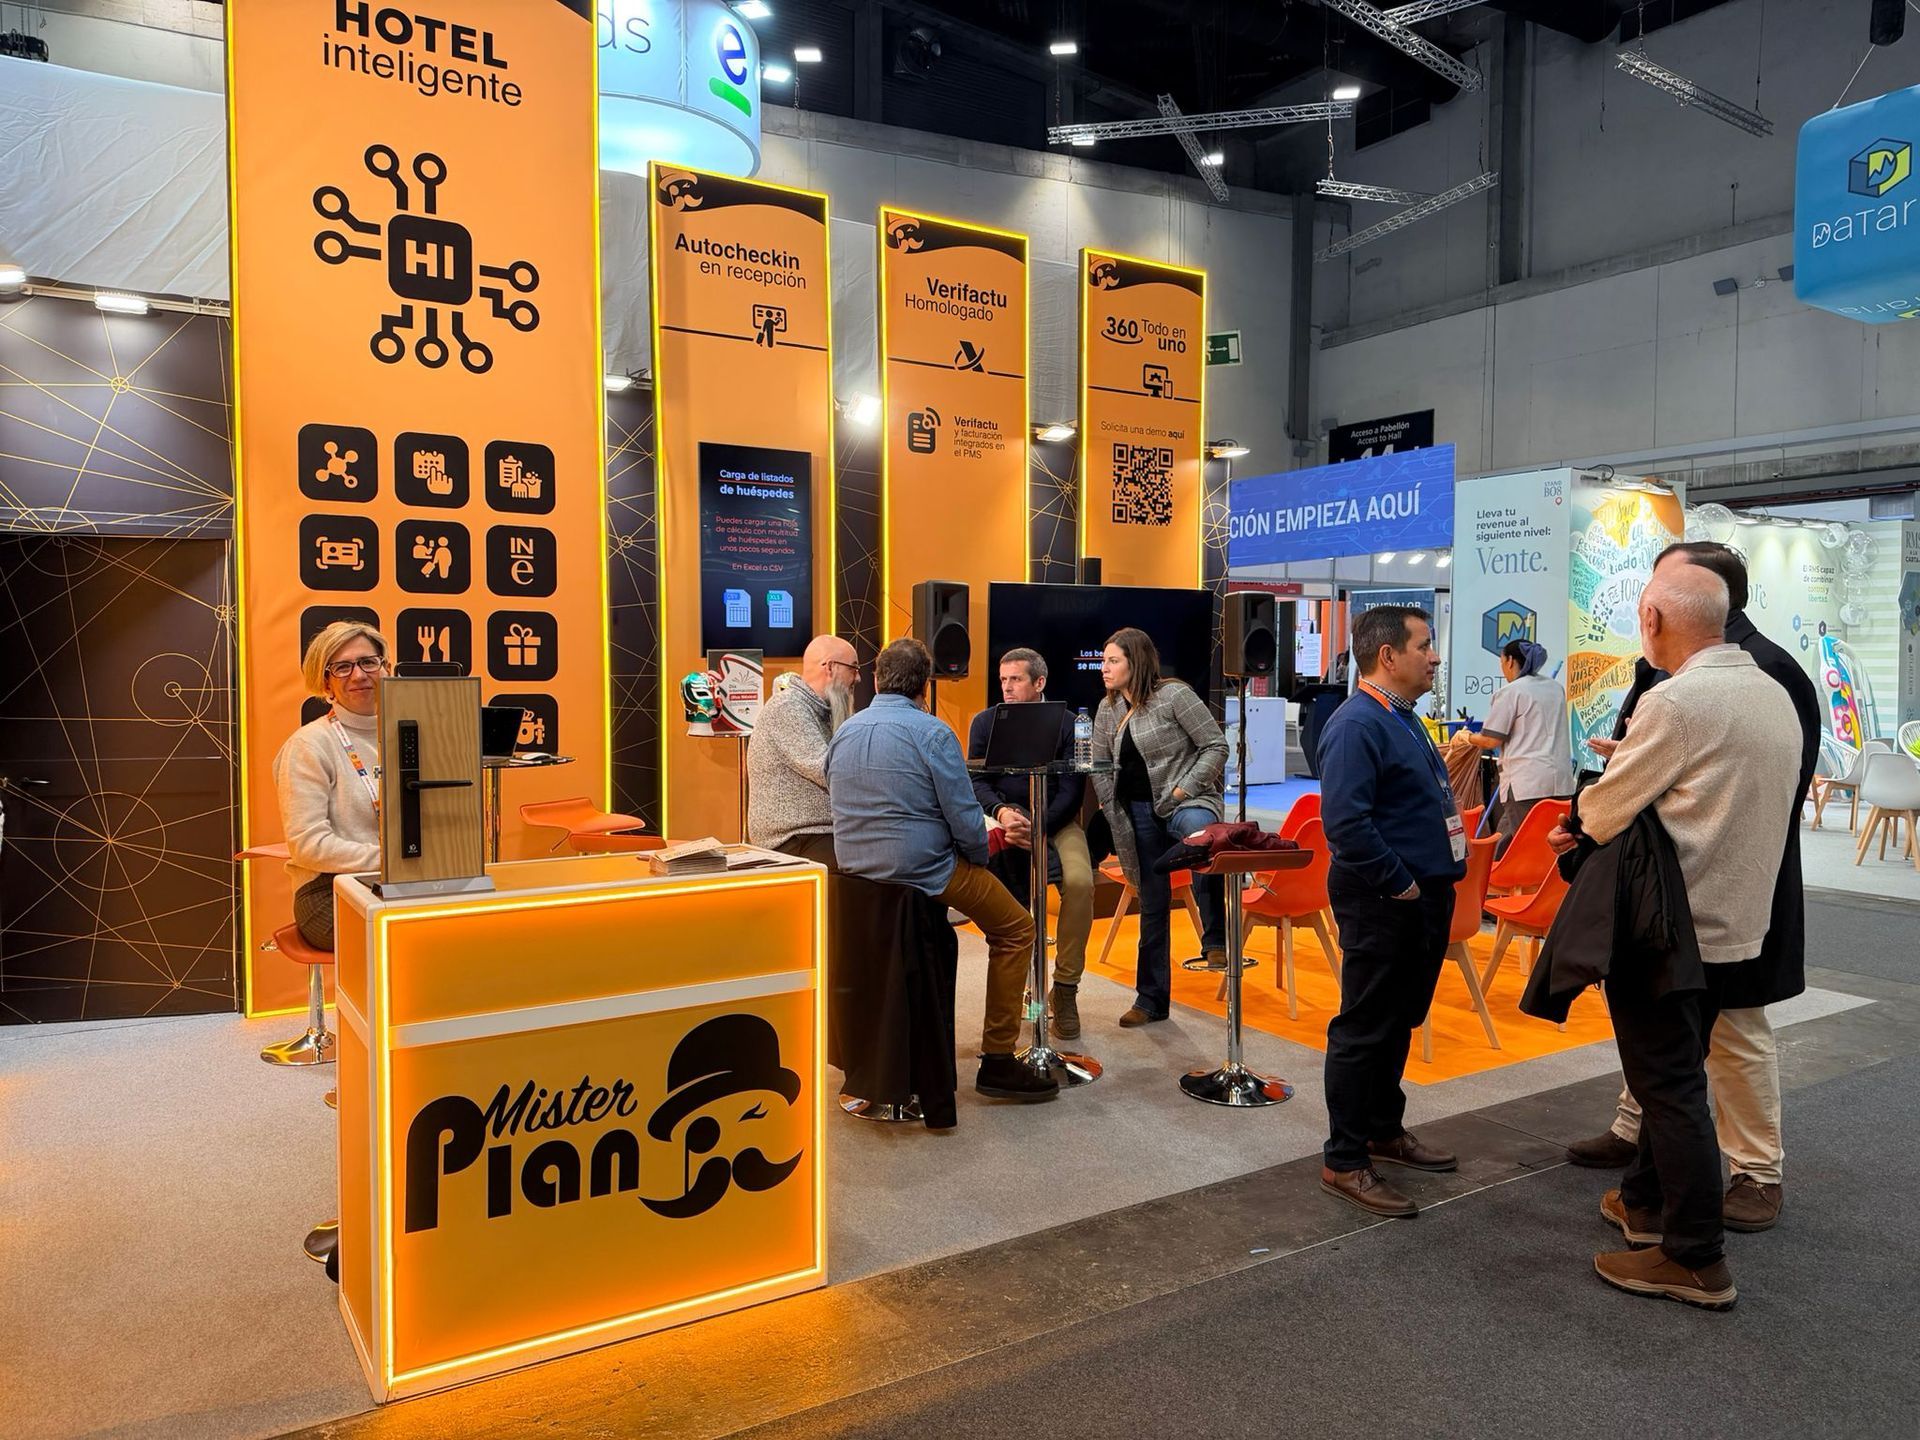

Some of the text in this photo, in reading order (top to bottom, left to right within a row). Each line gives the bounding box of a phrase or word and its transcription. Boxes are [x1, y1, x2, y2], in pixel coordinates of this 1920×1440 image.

[336, 0, 508, 69] HOTEL
[323, 33, 522, 107] inteligente
[675, 233, 800, 270] Autocheckin
[405, 238, 454, 283] HI
[700, 261, 807, 289] en recepción
[926, 277, 1007, 308] Verifactu
[905, 293, 994, 321] Homologado
[1106, 316, 1186, 339] 360 Todo en
[1158, 338, 1186, 353] uno
[953, 416, 998, 430] Verifactu
[1100, 420, 1185, 440] Solicita una demo aquí
[1350, 430, 1373, 438] Acceso
[1380, 421, 1410, 433] Pabellón
[953, 429, 1003, 440] y facturación
[1357, 432, 1402, 446] Access to Hall
[953, 439, 1005, 451] integrados en
[963, 451, 982, 459] PMS
[720, 469, 794, 484] Carga de listados
[720, 484, 794, 499] de huéspedes
[1275, 498, 1361, 534] EMPIEZA
[1365, 482, 1422, 522] AQUÍ
[1476, 508, 1516, 519] Lleva tu
[715, 515, 742, 524] Puedes
[1476, 517, 1529, 530] revenue al
[727, 535, 738, 543] de
[1476, 526, 1551, 542] siguiente nivel:
[510, 536, 534, 555] IN
[732, 562, 743, 570] En
[743, 563, 762, 571] Excel
[769, 564, 784, 572] CSV
[1475, 546, 1548, 575] Vente.
[1077, 662, 1087, 670] se
[483, 1075, 638, 1139] Mister
[405, 1095, 640, 1234] Plan
